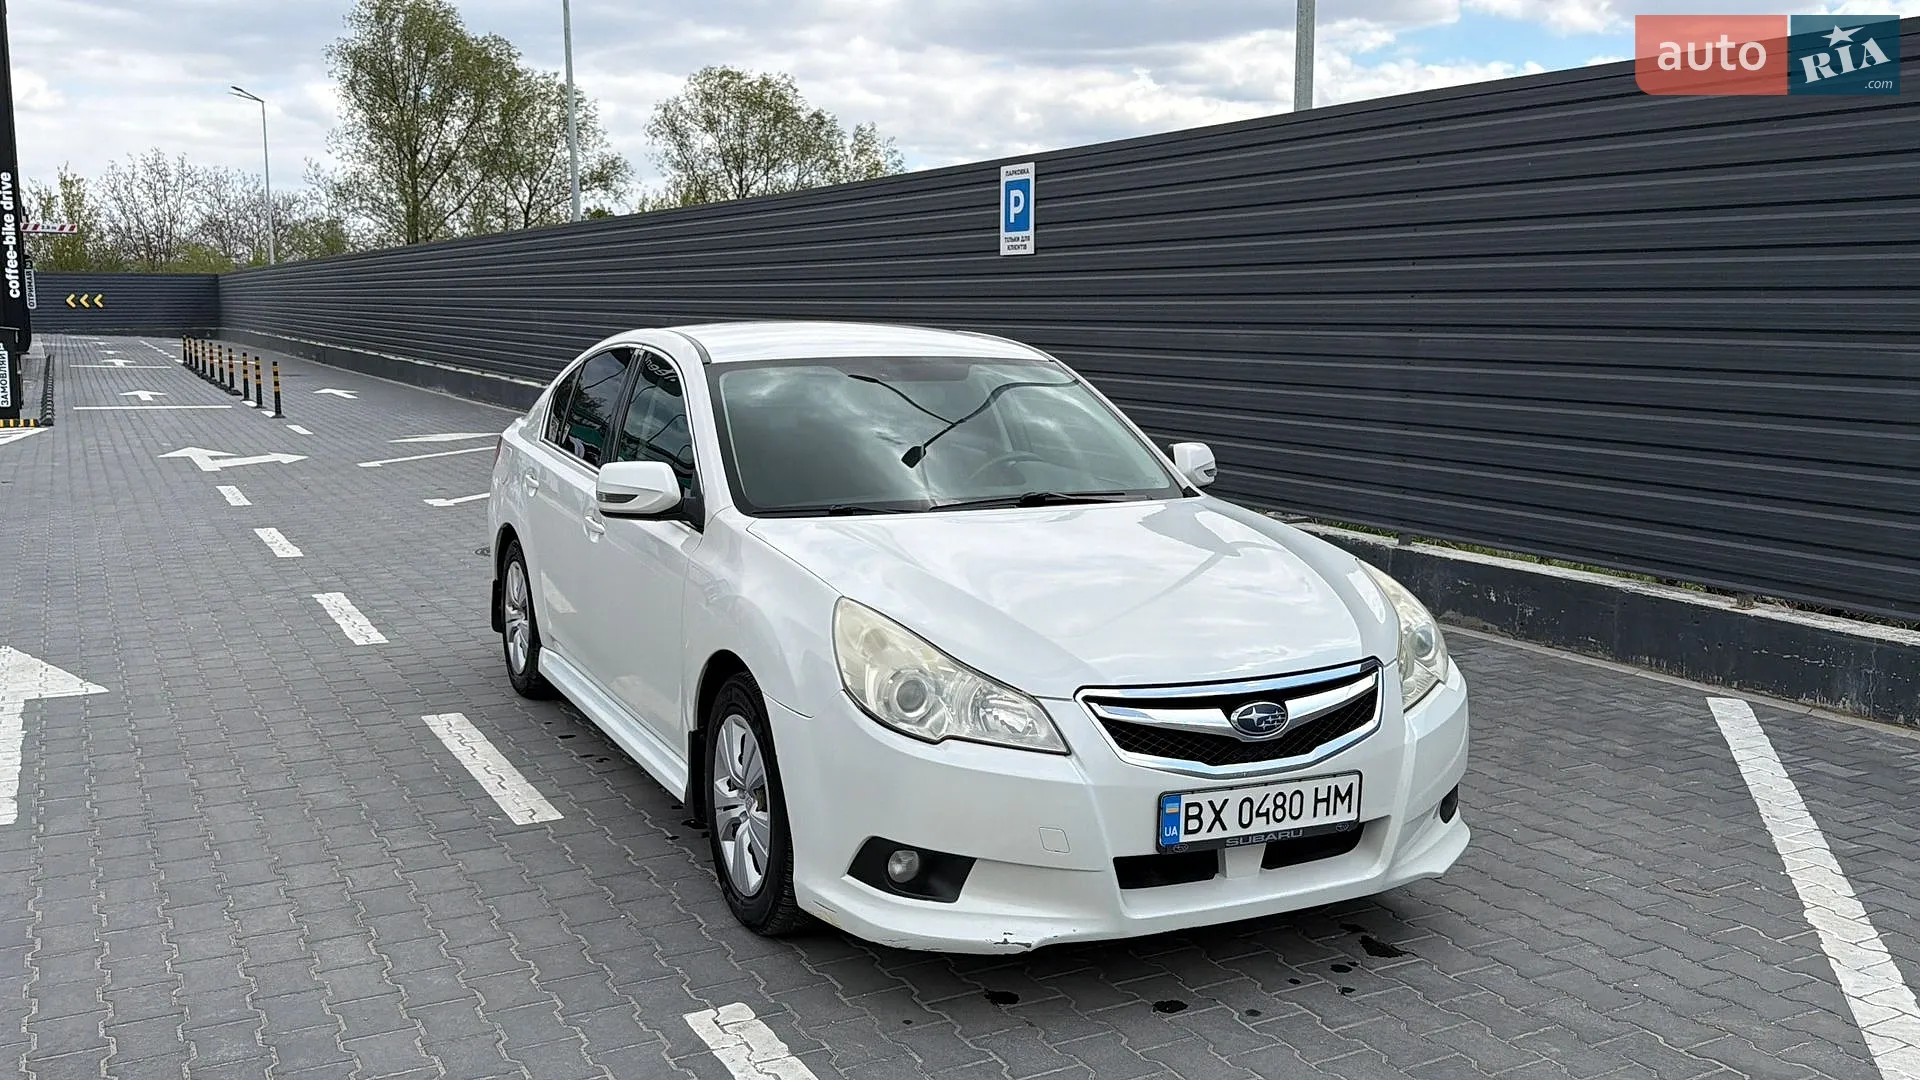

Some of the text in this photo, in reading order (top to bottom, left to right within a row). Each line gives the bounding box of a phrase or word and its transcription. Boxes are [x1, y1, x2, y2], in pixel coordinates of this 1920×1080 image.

[1009, 189, 1025, 223] P
[0, 171, 21, 299] coffee-bike drive
[1164, 782, 1354, 837] UA BX 0480 HM
[1225, 829, 1303, 847] SUBARU
